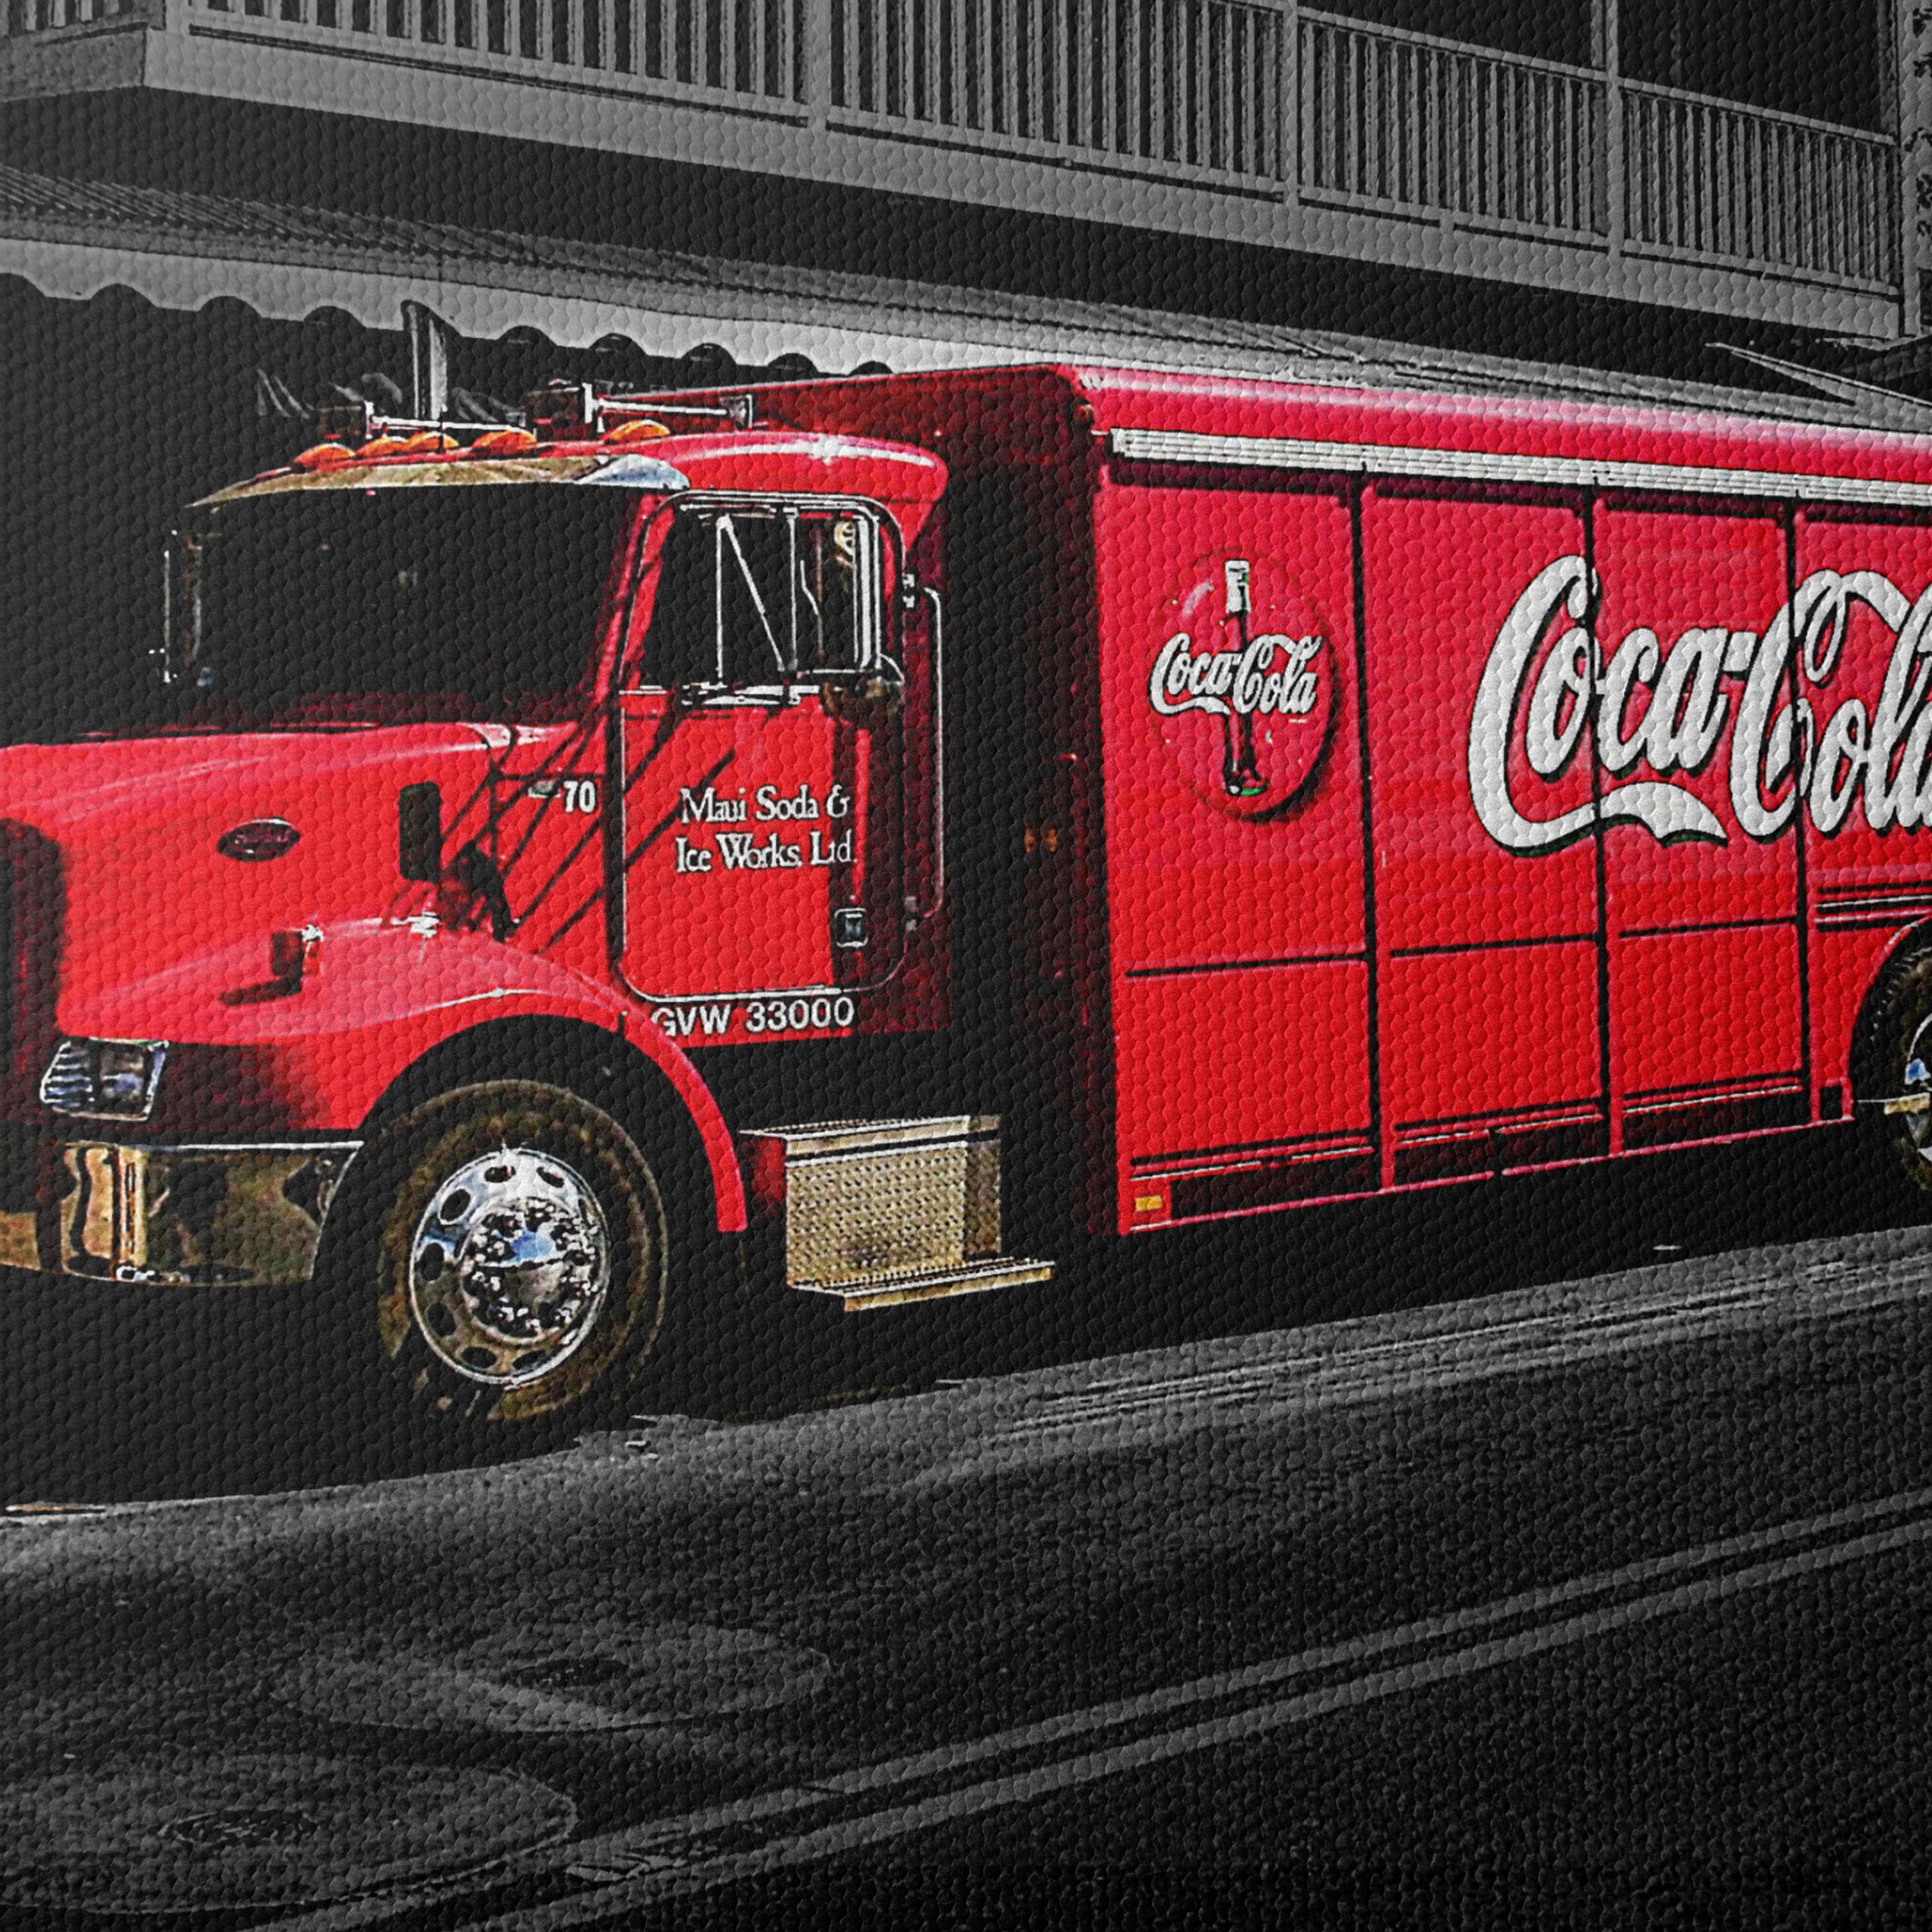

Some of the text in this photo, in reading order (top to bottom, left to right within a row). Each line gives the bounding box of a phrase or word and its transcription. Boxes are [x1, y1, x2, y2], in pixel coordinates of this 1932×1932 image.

[1149, 632, 1322, 715] Coca-Cola
[563, 780, 596, 813] 70
[680, 784, 851, 823] Maui Soda &
[675, 835, 712, 872] Ice
[650, 996, 854, 1037] GVW 33000
